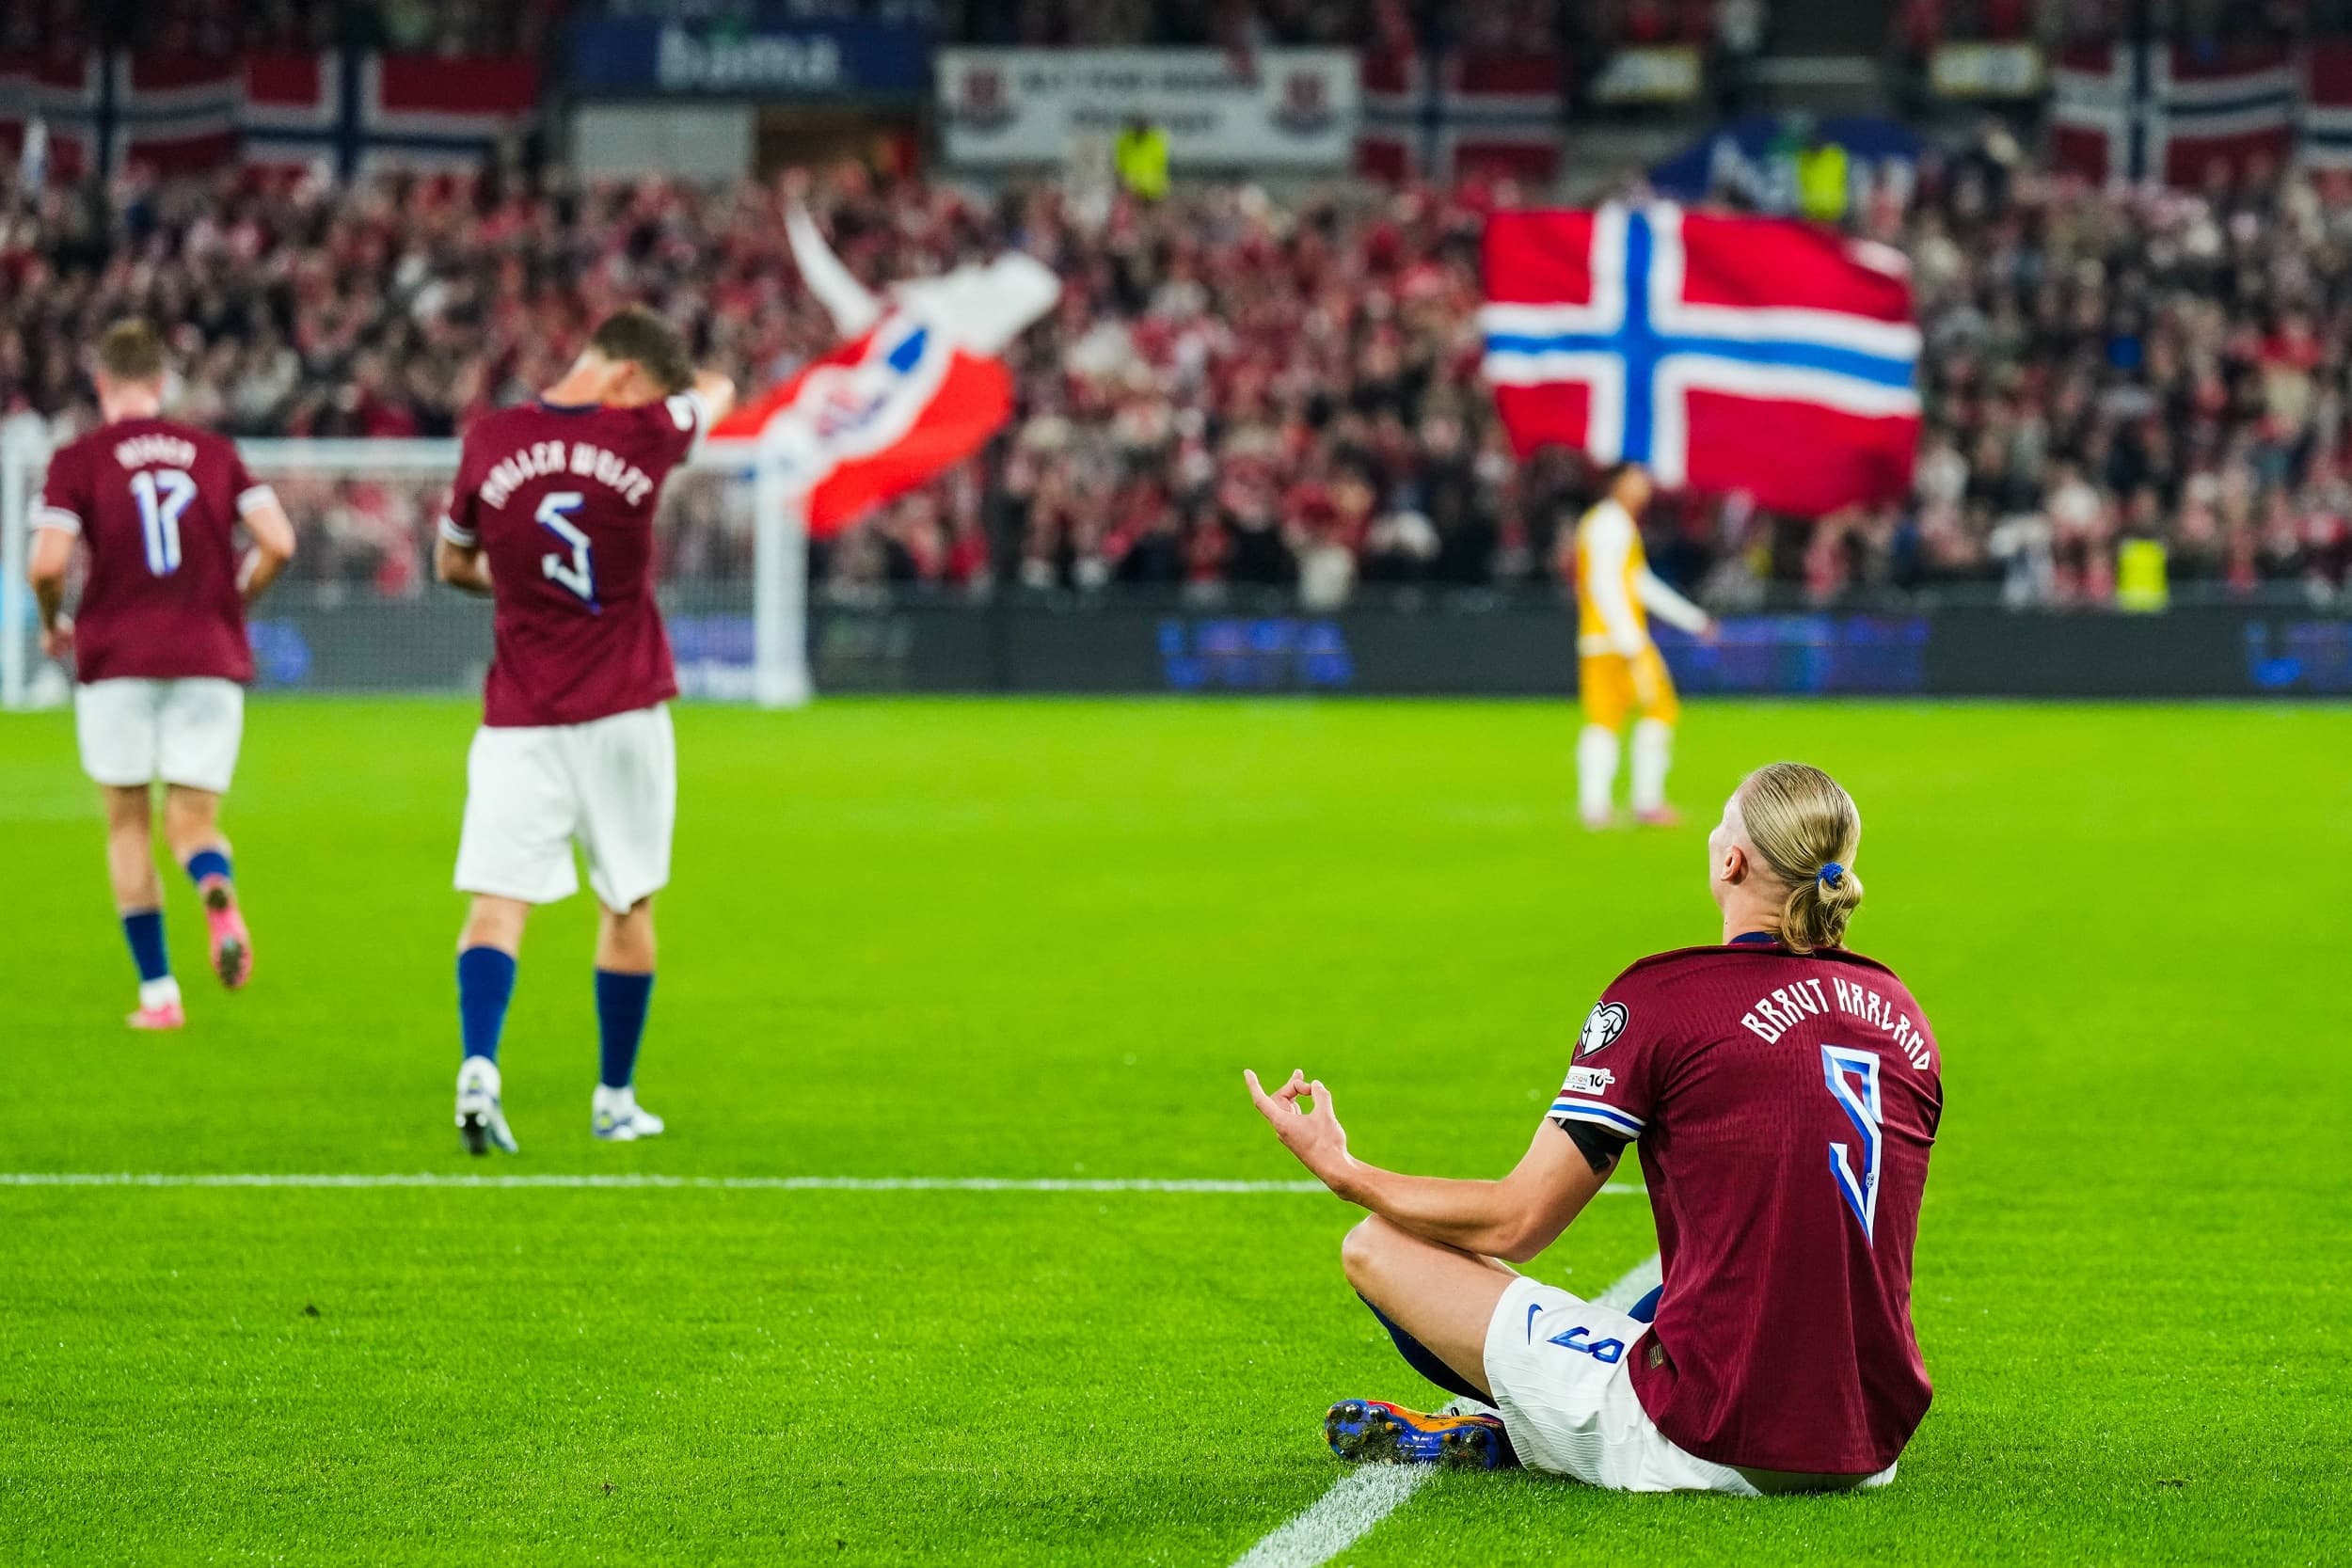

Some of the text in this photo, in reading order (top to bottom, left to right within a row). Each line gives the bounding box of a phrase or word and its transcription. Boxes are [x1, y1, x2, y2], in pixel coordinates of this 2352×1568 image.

[130, 469, 199, 578] 17
[534, 491, 602, 616] 5
[1740, 976, 1931, 1070] BRAUT HAALAND
[1820, 1043, 1884, 1250] 9
[1546, 1325, 1626, 1364] 9
